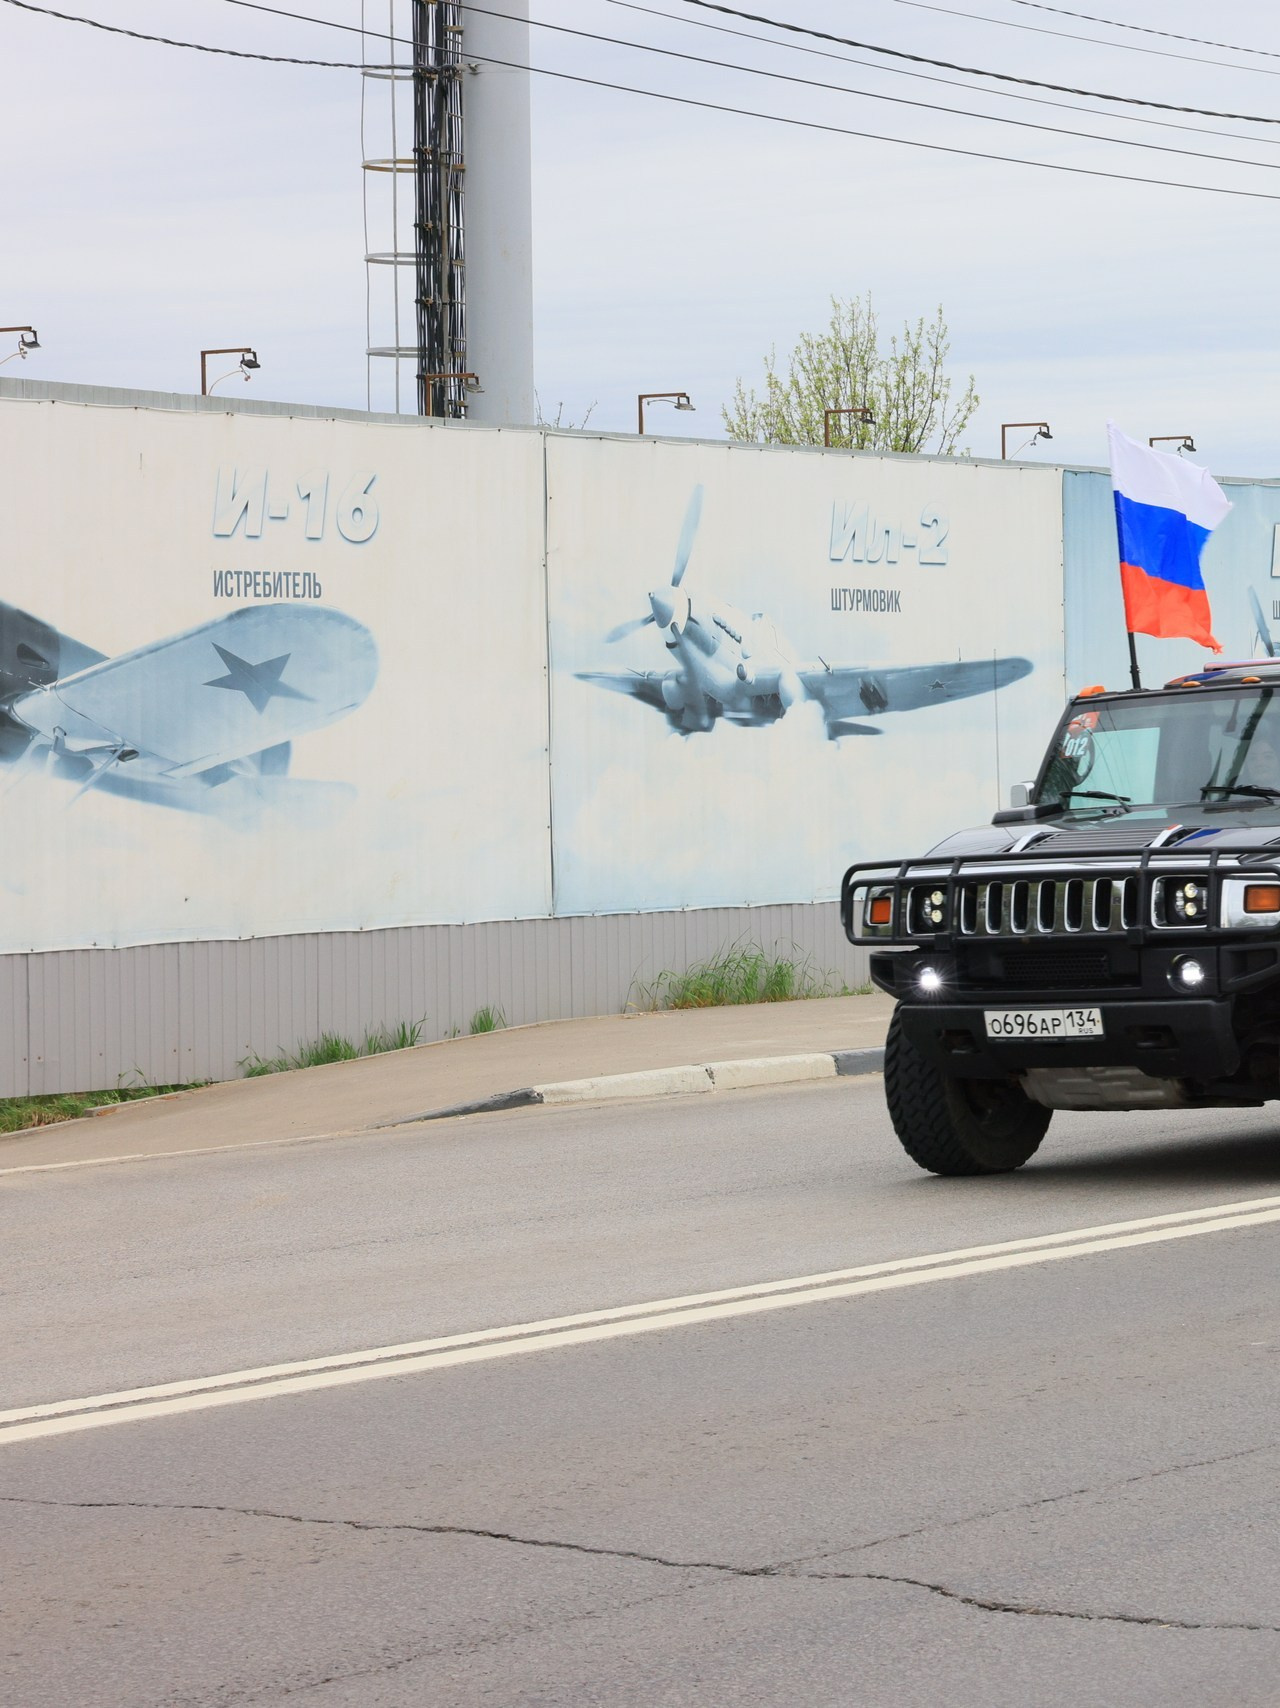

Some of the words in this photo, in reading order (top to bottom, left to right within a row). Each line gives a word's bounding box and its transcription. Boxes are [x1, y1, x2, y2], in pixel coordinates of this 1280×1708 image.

[213, 464, 379, 543] И-16
[829, 499, 949, 566] Ил-2
[213, 570, 322, 599] ИСТРЕБИТЕЛЬ
[831, 588, 901, 613] ШТУРМОВИК
[1066, 1010, 1096, 1028] 134
